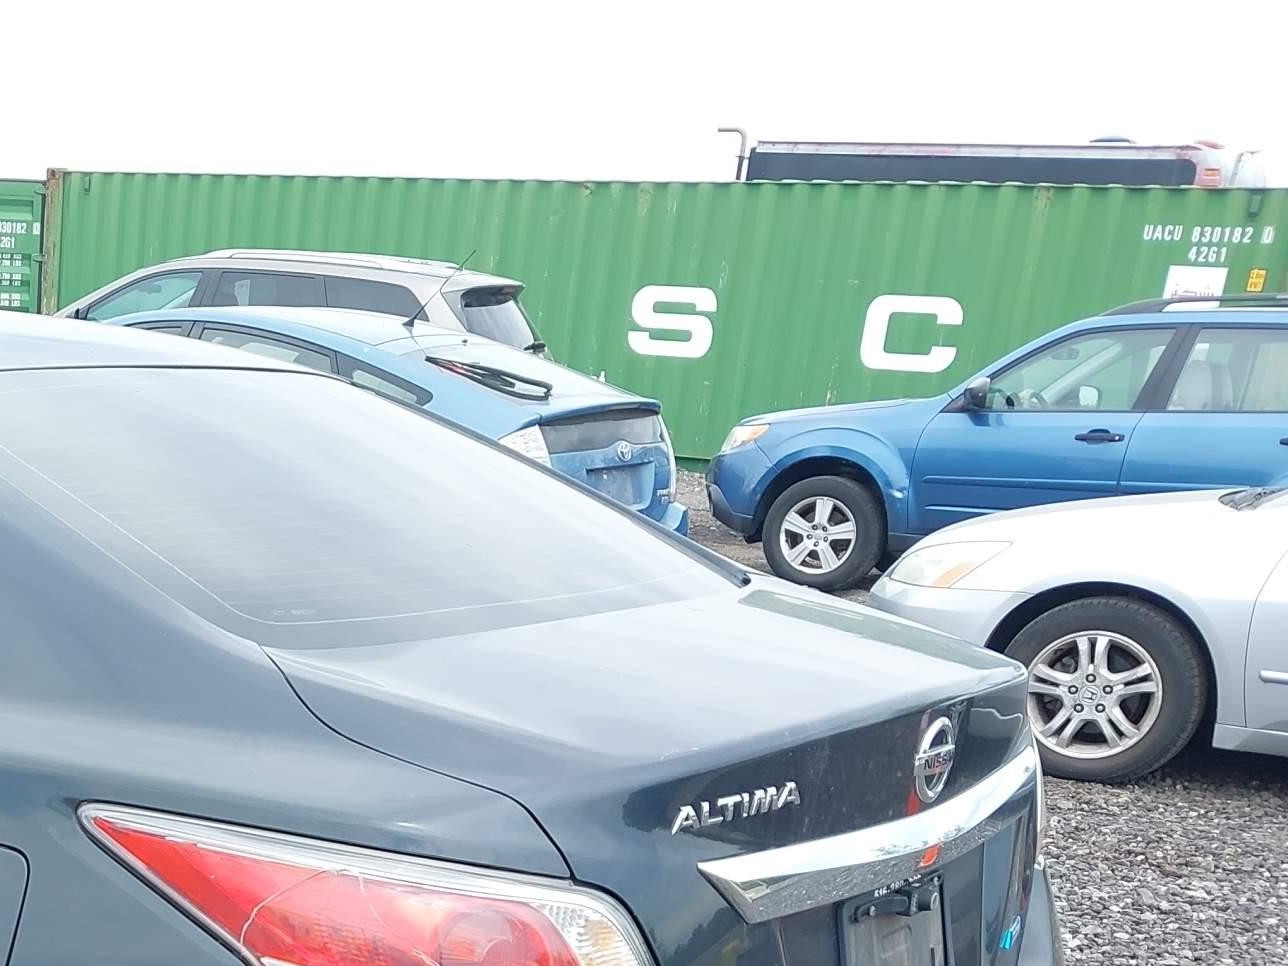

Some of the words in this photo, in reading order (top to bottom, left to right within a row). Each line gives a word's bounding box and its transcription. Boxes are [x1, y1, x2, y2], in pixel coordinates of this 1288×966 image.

[1143, 225, 1184, 241] UACU
[1191, 226, 1254, 244] 830182
[1187, 246, 1228, 263] 42G1
[671, 781, 801, 836] ALTIMA
